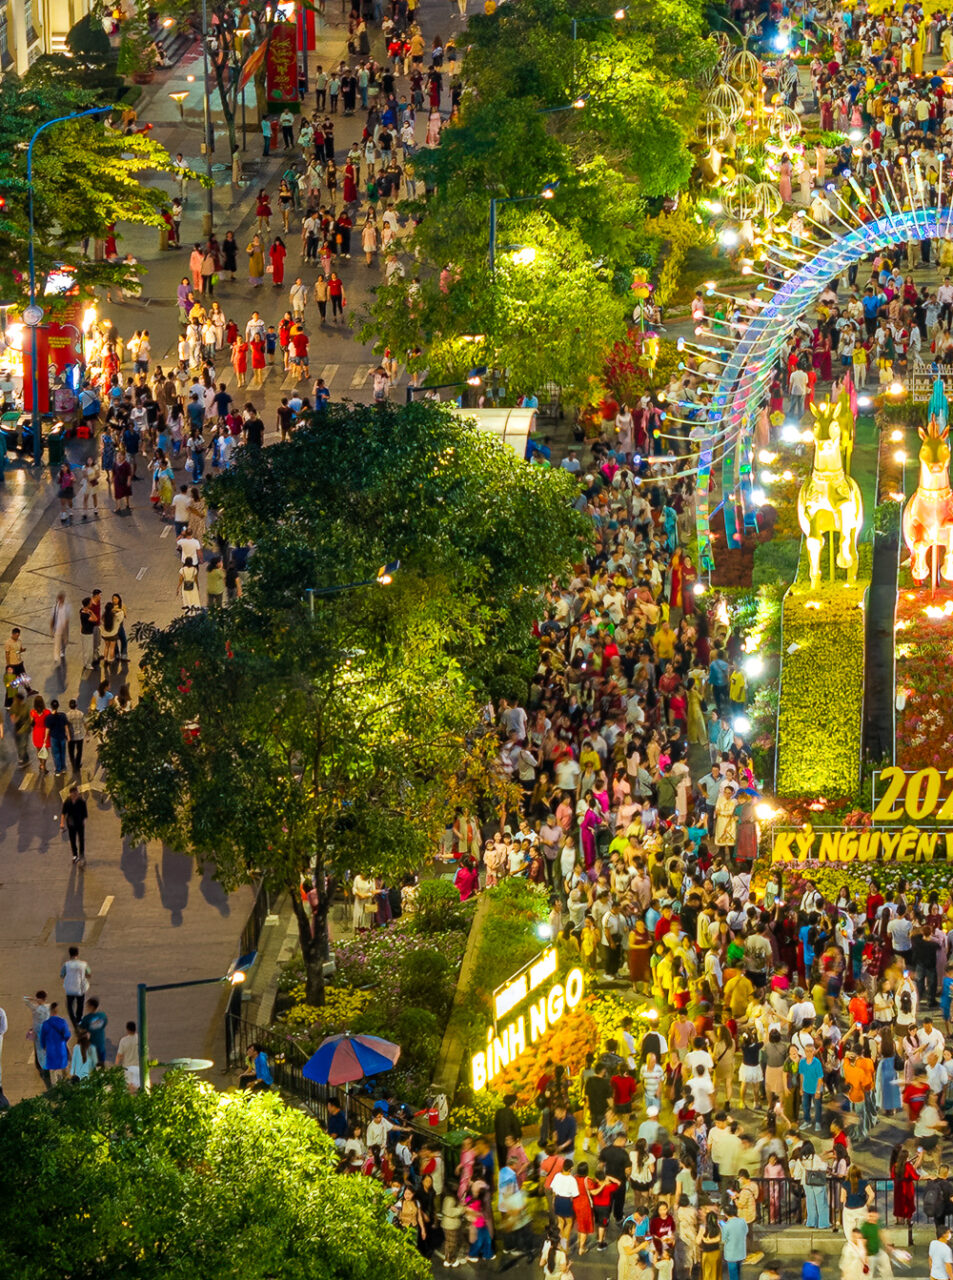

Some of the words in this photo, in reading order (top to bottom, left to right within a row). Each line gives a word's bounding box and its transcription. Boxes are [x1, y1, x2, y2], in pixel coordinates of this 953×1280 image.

[818, 824, 937, 862] NGUYÊN
[471, 1014, 526, 1092] BÍNH
[529, 966, 584, 1044] NGỌ
